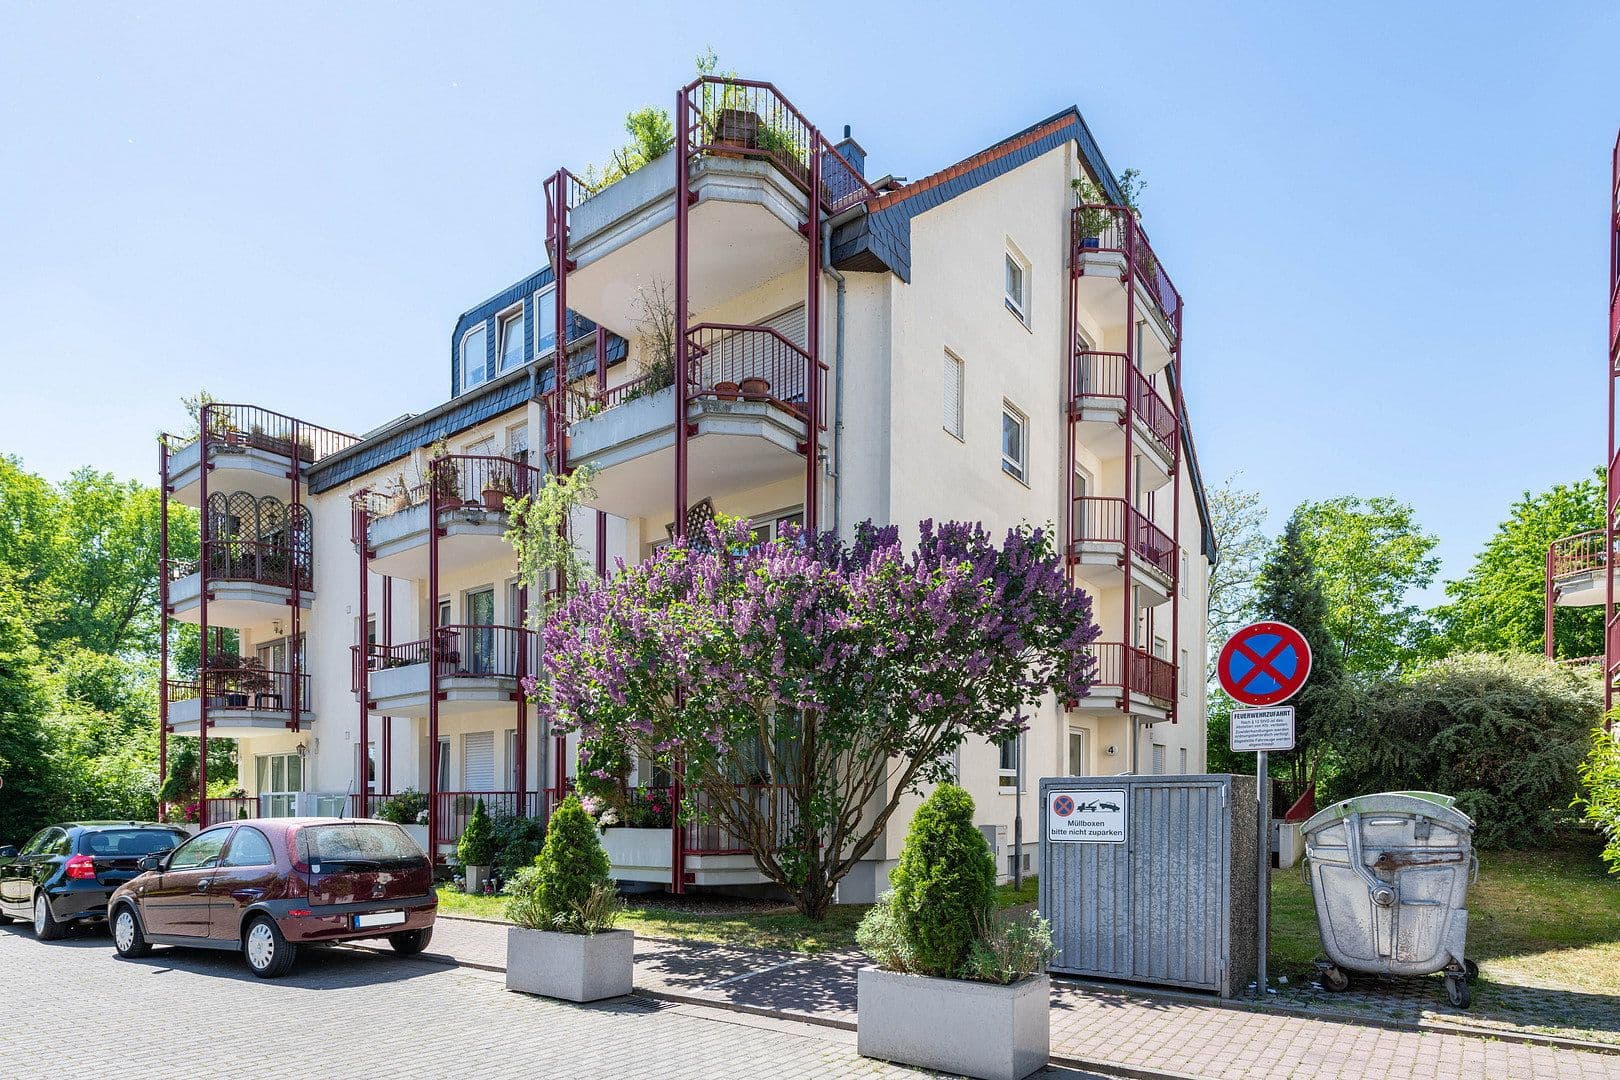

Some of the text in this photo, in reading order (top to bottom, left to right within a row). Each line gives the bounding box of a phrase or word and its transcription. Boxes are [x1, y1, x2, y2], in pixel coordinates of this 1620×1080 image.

[1234, 711, 1290, 719] FEUERWEHRZUFAHRT
[1108, 746, 1114, 754] 4
[1088, 829, 1123, 837] zuparken
